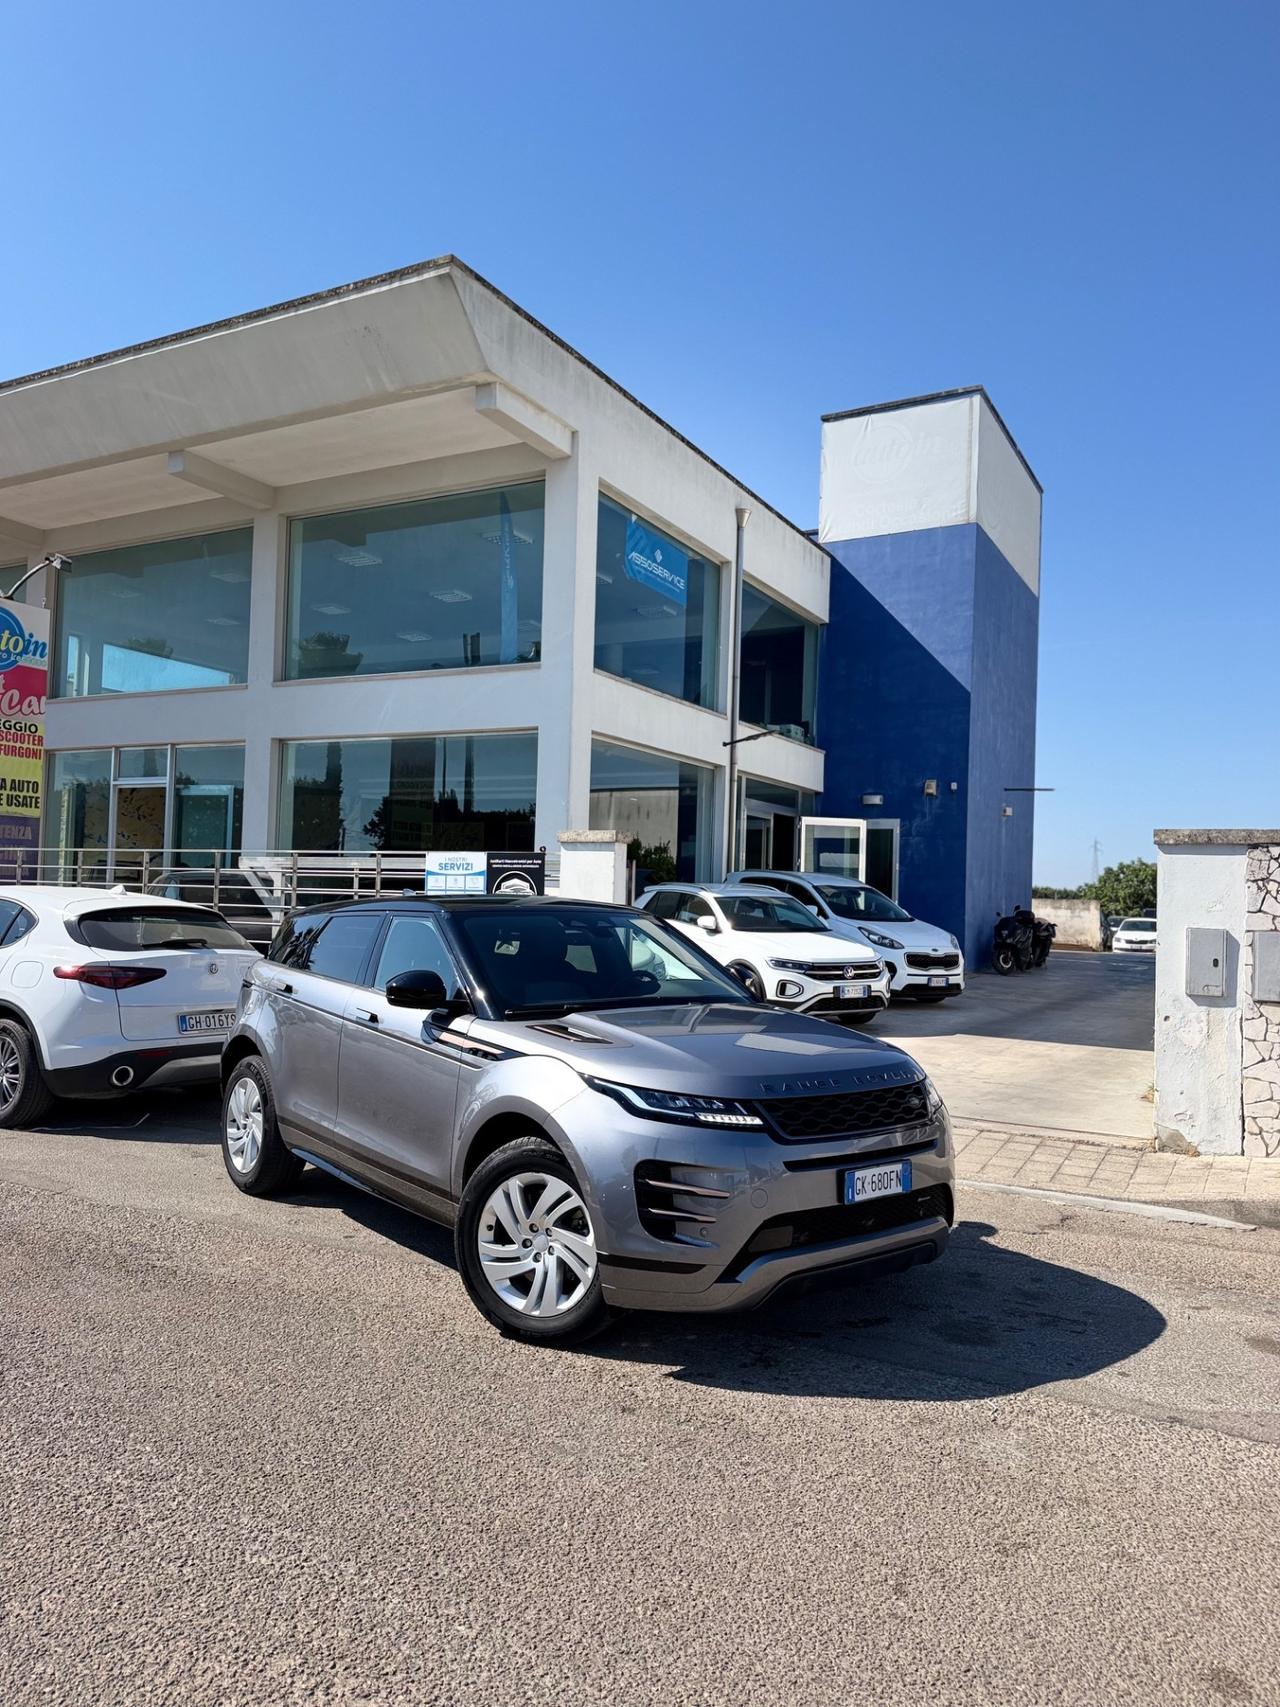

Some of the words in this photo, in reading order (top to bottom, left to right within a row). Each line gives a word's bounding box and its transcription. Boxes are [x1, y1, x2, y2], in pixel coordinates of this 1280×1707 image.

[628, 551, 685, 590] ASSOSERVICE
[0, 730, 44, 746] SCOOTER
[0, 743, 42, 760] FURGONI
[9, 778, 39, 794] AUTO
[6, 793, 40, 809] USATE
[438, 862, 473, 871] SERVIZI
[759, 1078, 841, 1092] RANGE
